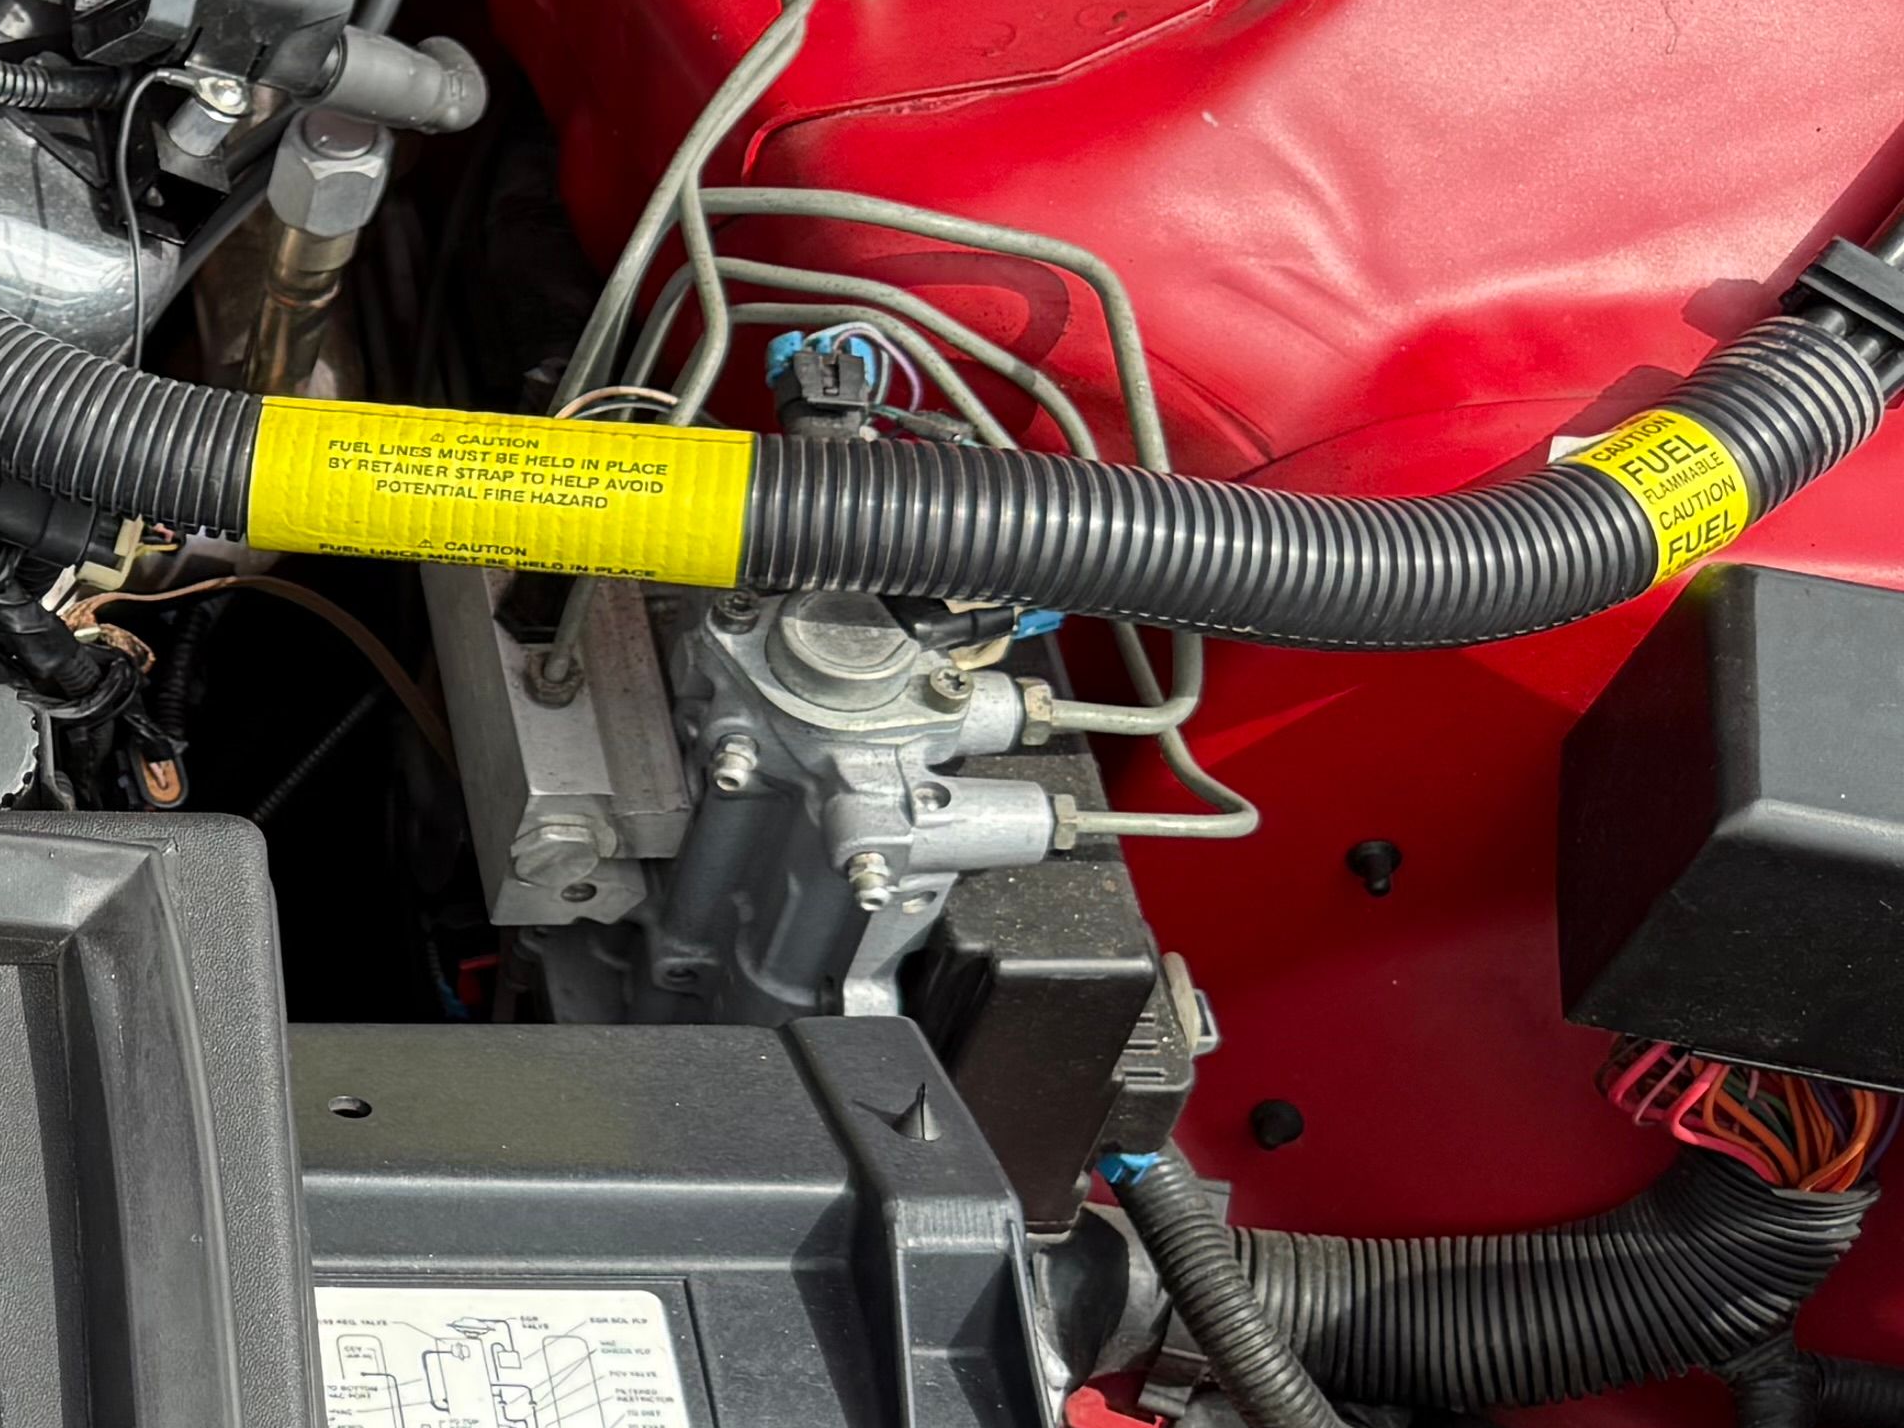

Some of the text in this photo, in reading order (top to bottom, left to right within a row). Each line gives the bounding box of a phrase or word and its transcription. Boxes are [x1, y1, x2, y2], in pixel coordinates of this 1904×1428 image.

[328, 440, 669, 477] FUEL LINES MUST BE HELD IN PLACE
[456, 434, 541, 450] CAUTION
[1591, 415, 1677, 462] CAUTION
[328, 457, 665, 495] BY RETAINER STRAP TO HELP AVOID
[1619, 434, 1709, 486] FUEL
[1642, 451, 1725, 505] FLAMMABLE
[375, 479, 609, 510] POTENTIAL FIRE HAZARD
[1658, 474, 1737, 531] CAUTION
[443, 541, 528, 557] CAUTION
[1667, 509, 1737, 566] FUEL
